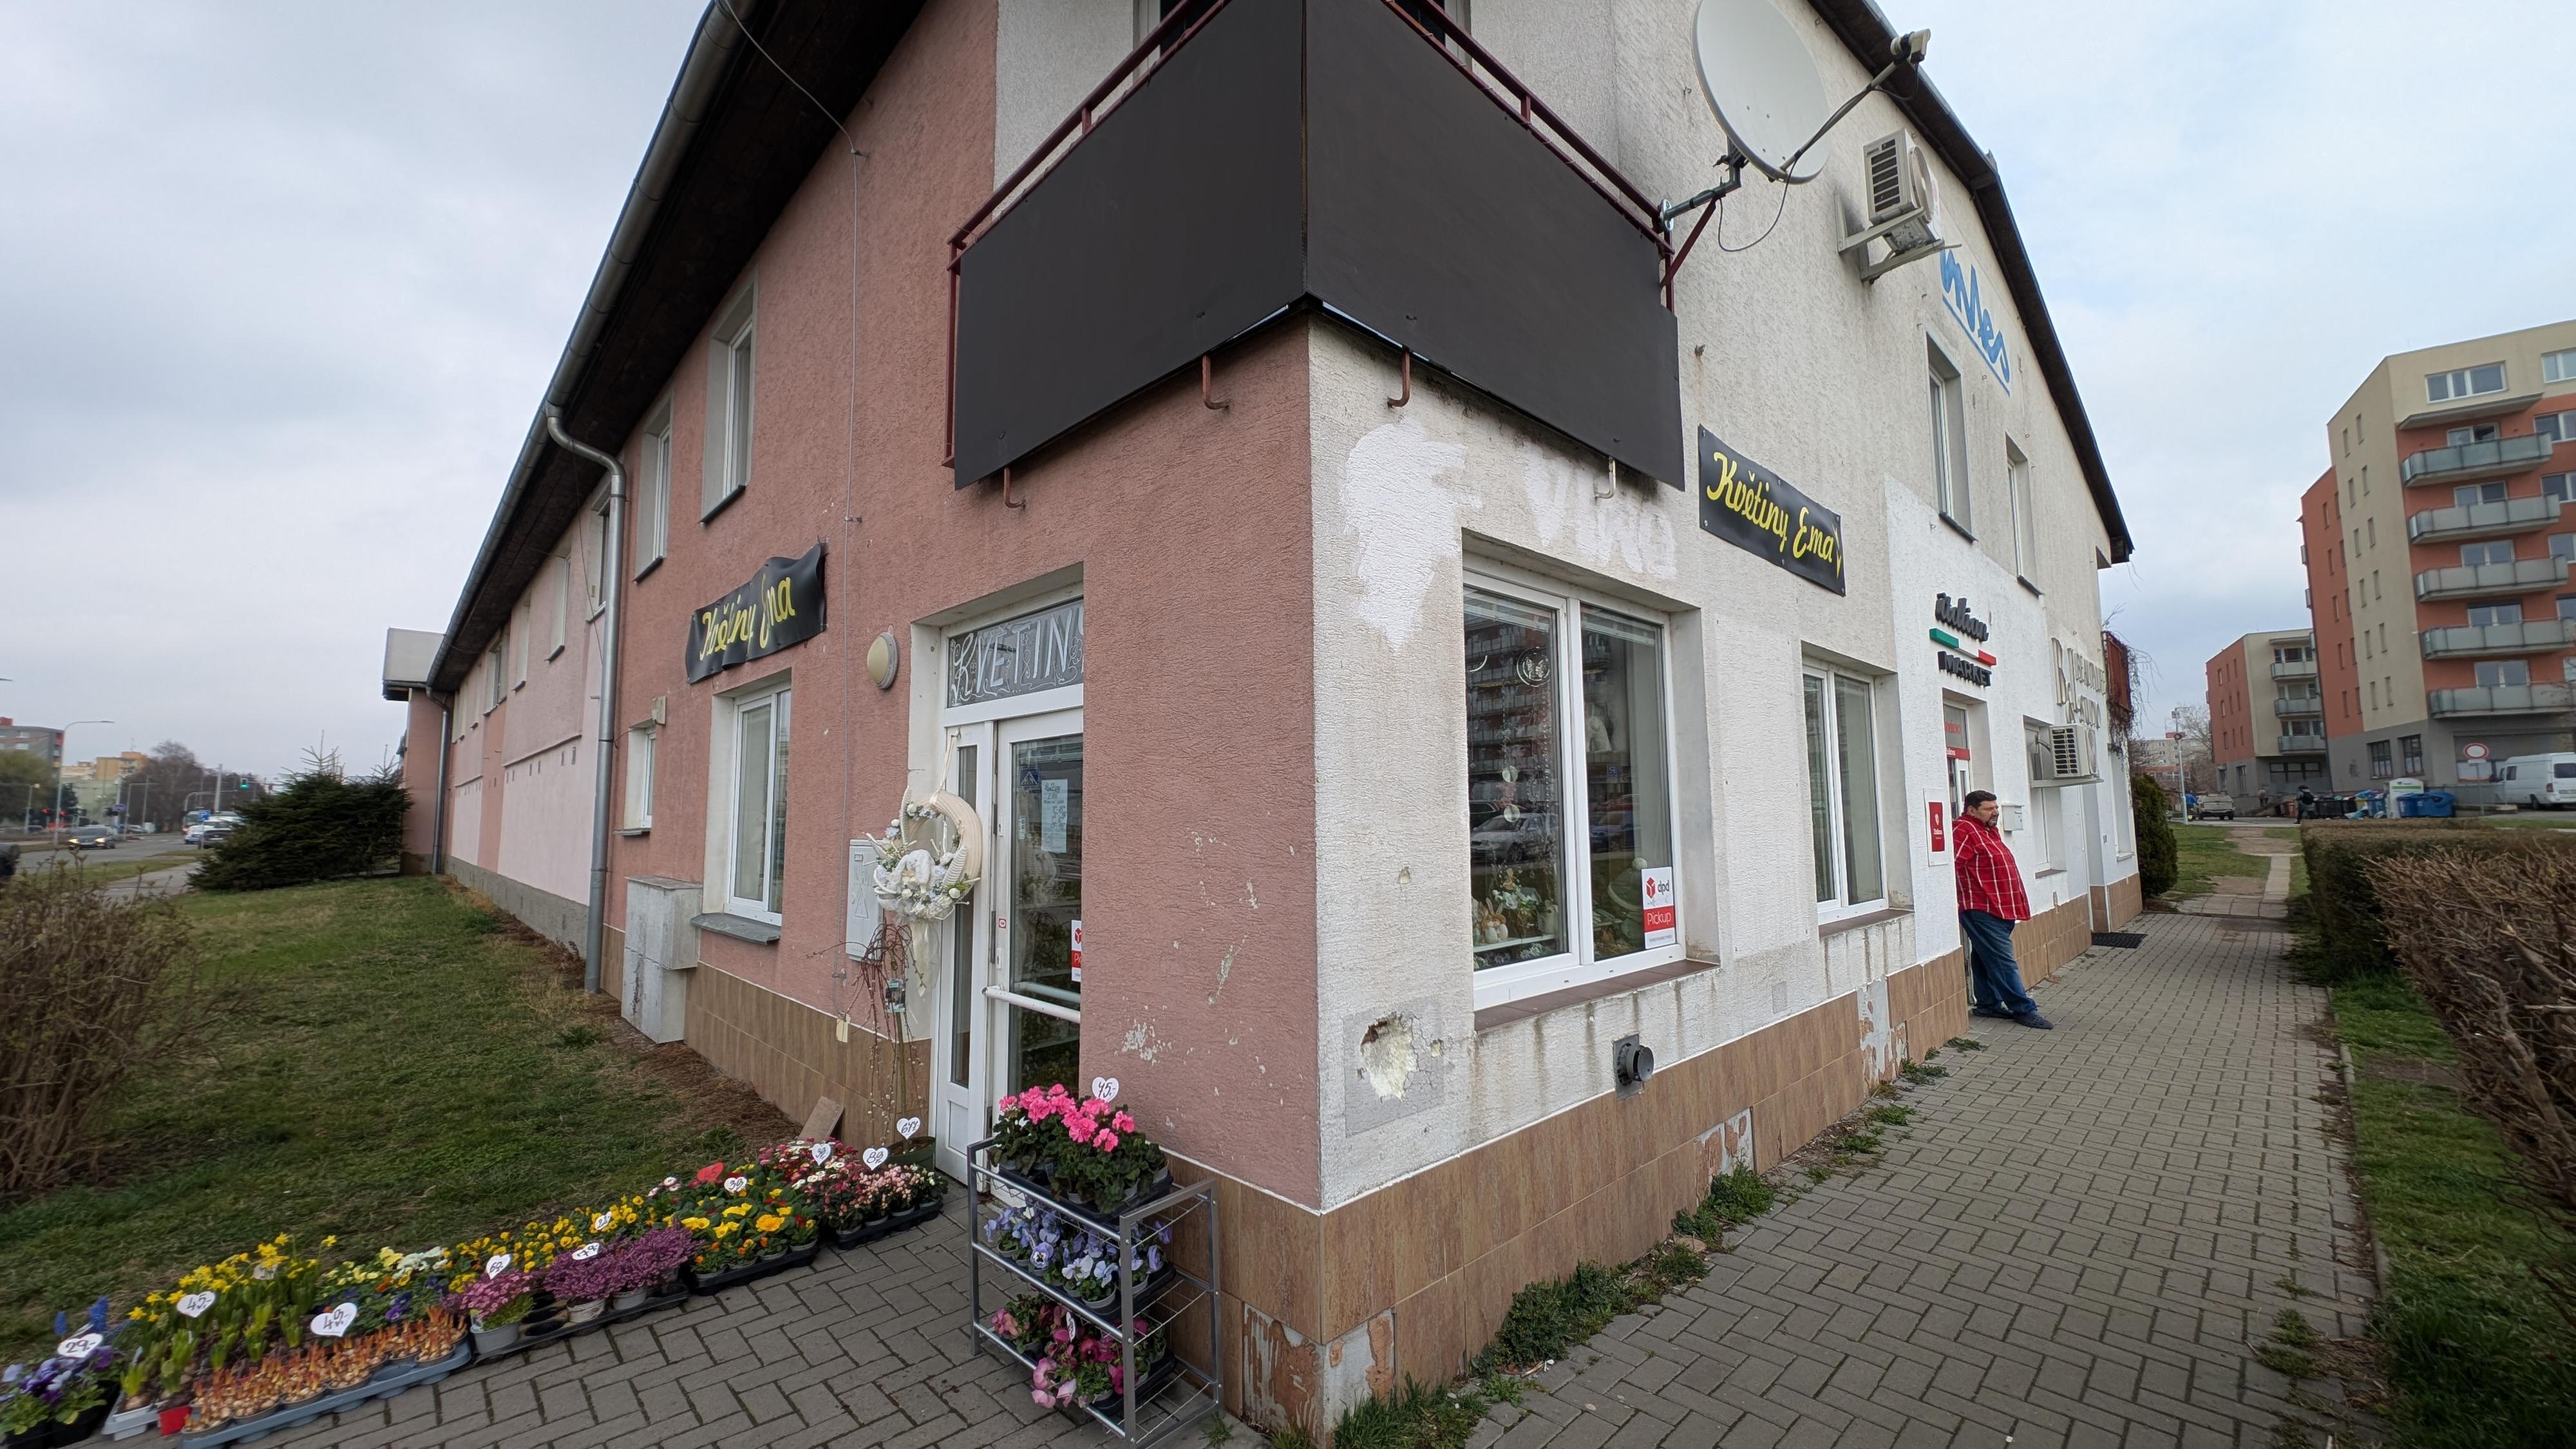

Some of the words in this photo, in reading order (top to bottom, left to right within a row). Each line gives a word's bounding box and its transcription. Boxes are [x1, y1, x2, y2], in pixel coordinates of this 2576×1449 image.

[1707, 451, 1788, 553] Květiny
[1793, 507, 1833, 563] Ema
[1938, 651, 1992, 687] MARKET
[1657, 879, 1670, 896] dpd
[1647, 910, 1672, 925] Pickup
[66, 1339, 96, 1353] 29.-
